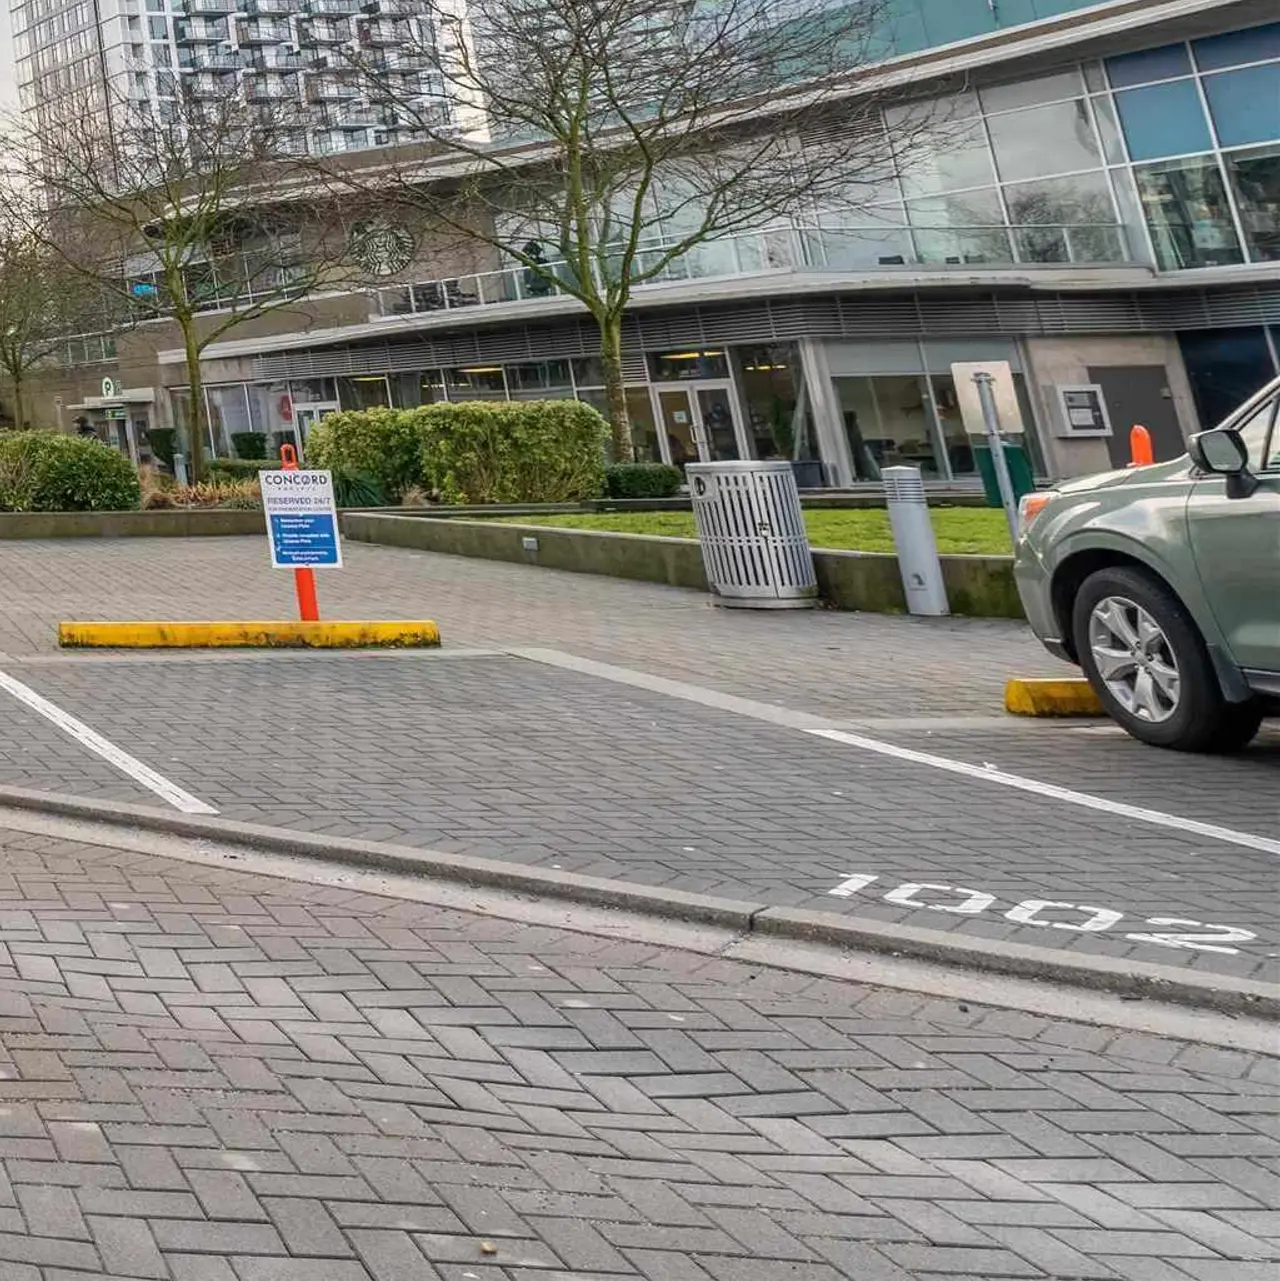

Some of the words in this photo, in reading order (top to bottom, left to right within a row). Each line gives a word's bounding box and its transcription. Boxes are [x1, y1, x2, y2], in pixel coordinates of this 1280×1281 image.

[265, 475, 328, 485] CONCORD
[268, 497, 312, 505] RESERVED
[828, 873, 1258, 955] 1002
